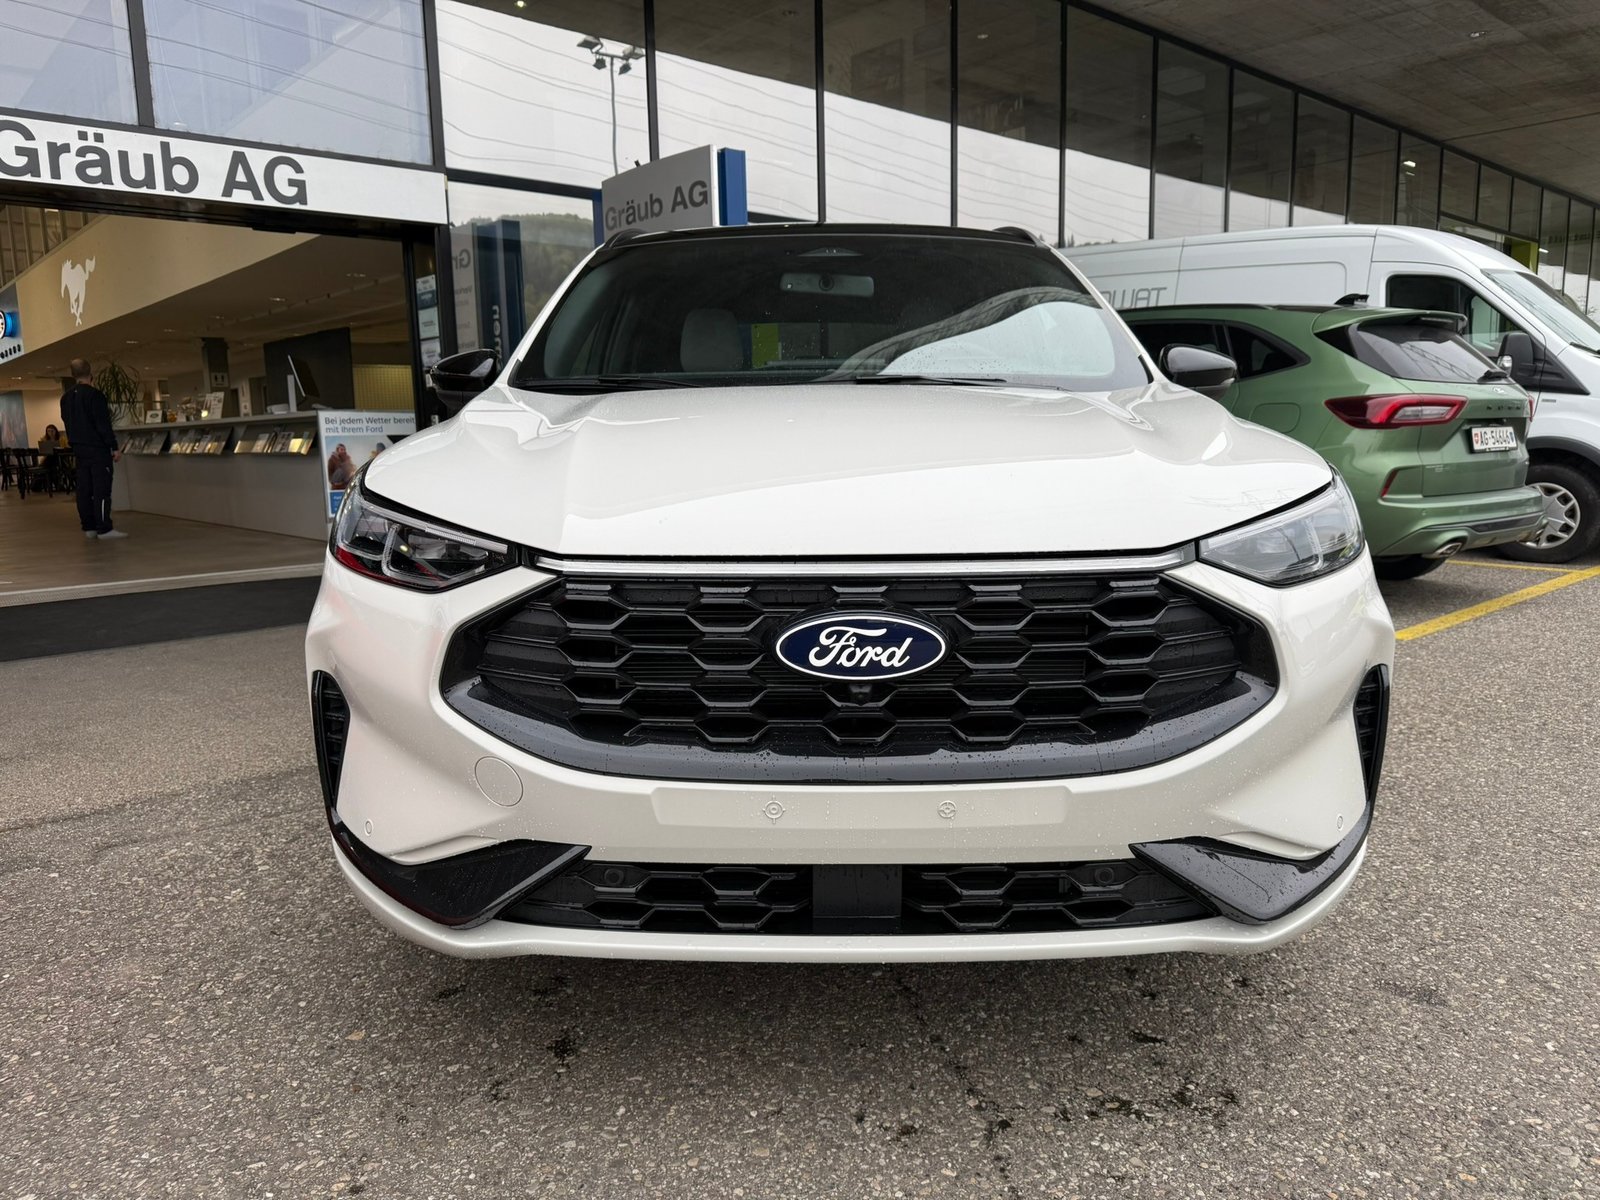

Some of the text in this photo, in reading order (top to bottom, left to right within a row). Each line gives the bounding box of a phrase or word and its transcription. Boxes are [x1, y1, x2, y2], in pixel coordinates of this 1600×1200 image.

[0, 120, 308, 206] Gräub AG
[605, 180, 708, 231] Gräub AG
[325, 417, 338, 425] Bei
[339, 417, 364, 426] jedem
[365, 416, 391, 425] Wetter
[325, 425, 384, 433] mit Ihrem Ford
[808, 626, 913, 668] Ford
